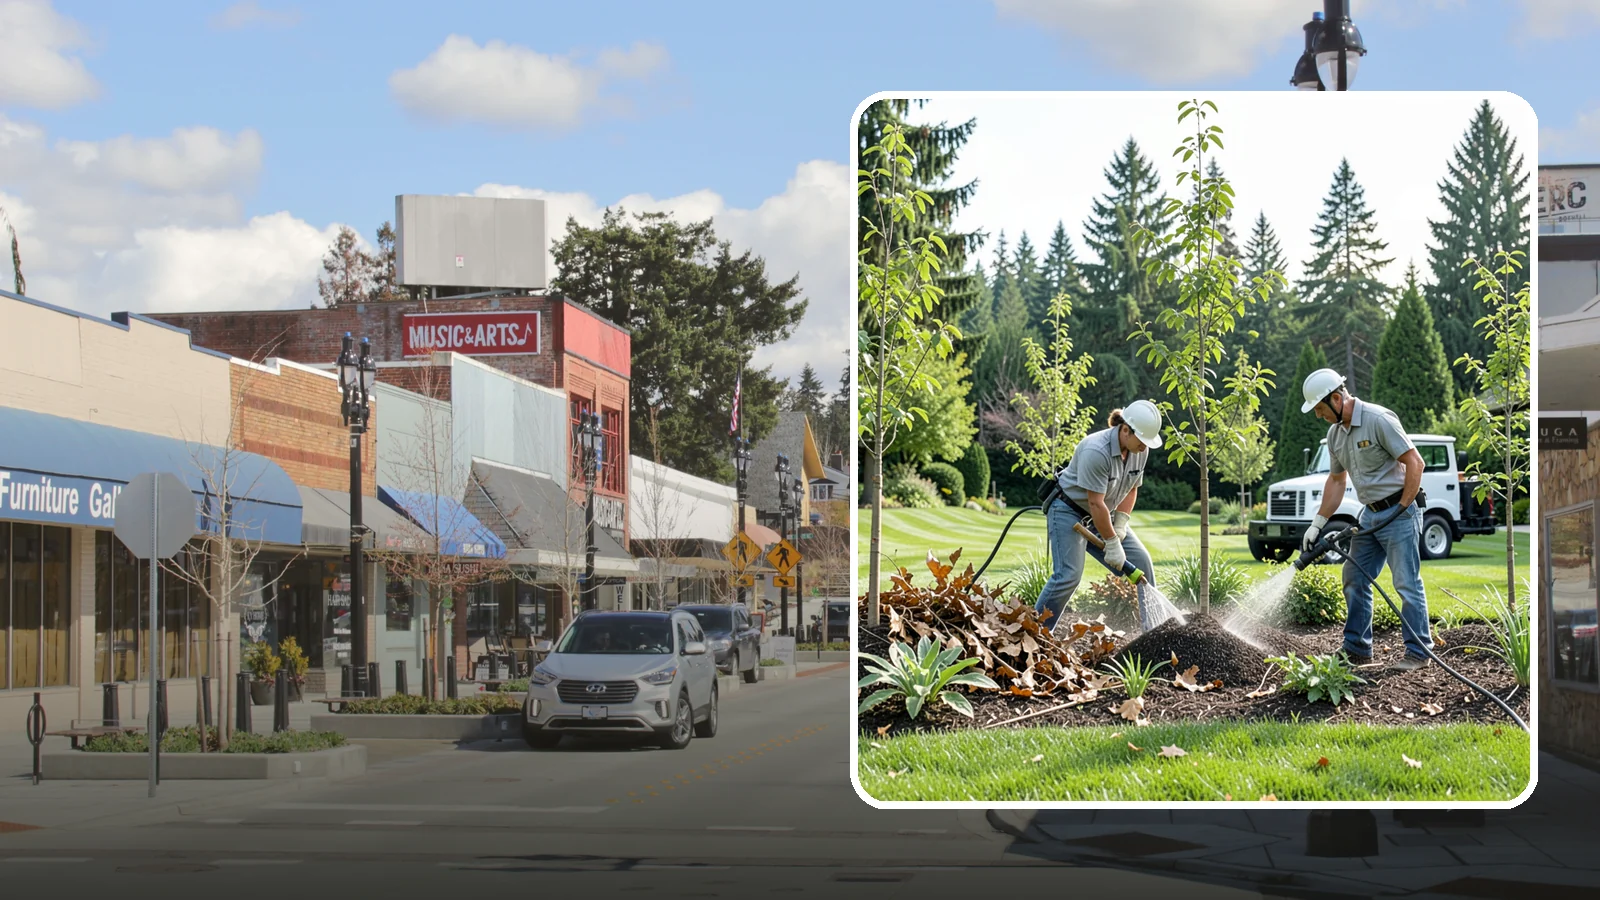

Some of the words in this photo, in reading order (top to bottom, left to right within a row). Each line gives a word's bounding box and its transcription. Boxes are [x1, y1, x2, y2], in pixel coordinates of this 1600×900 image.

[408, 322, 519, 349] MUSIC&ARTS
[0, 471, 79, 515] Furniture
[453, 563, 479, 574] SUSHI
